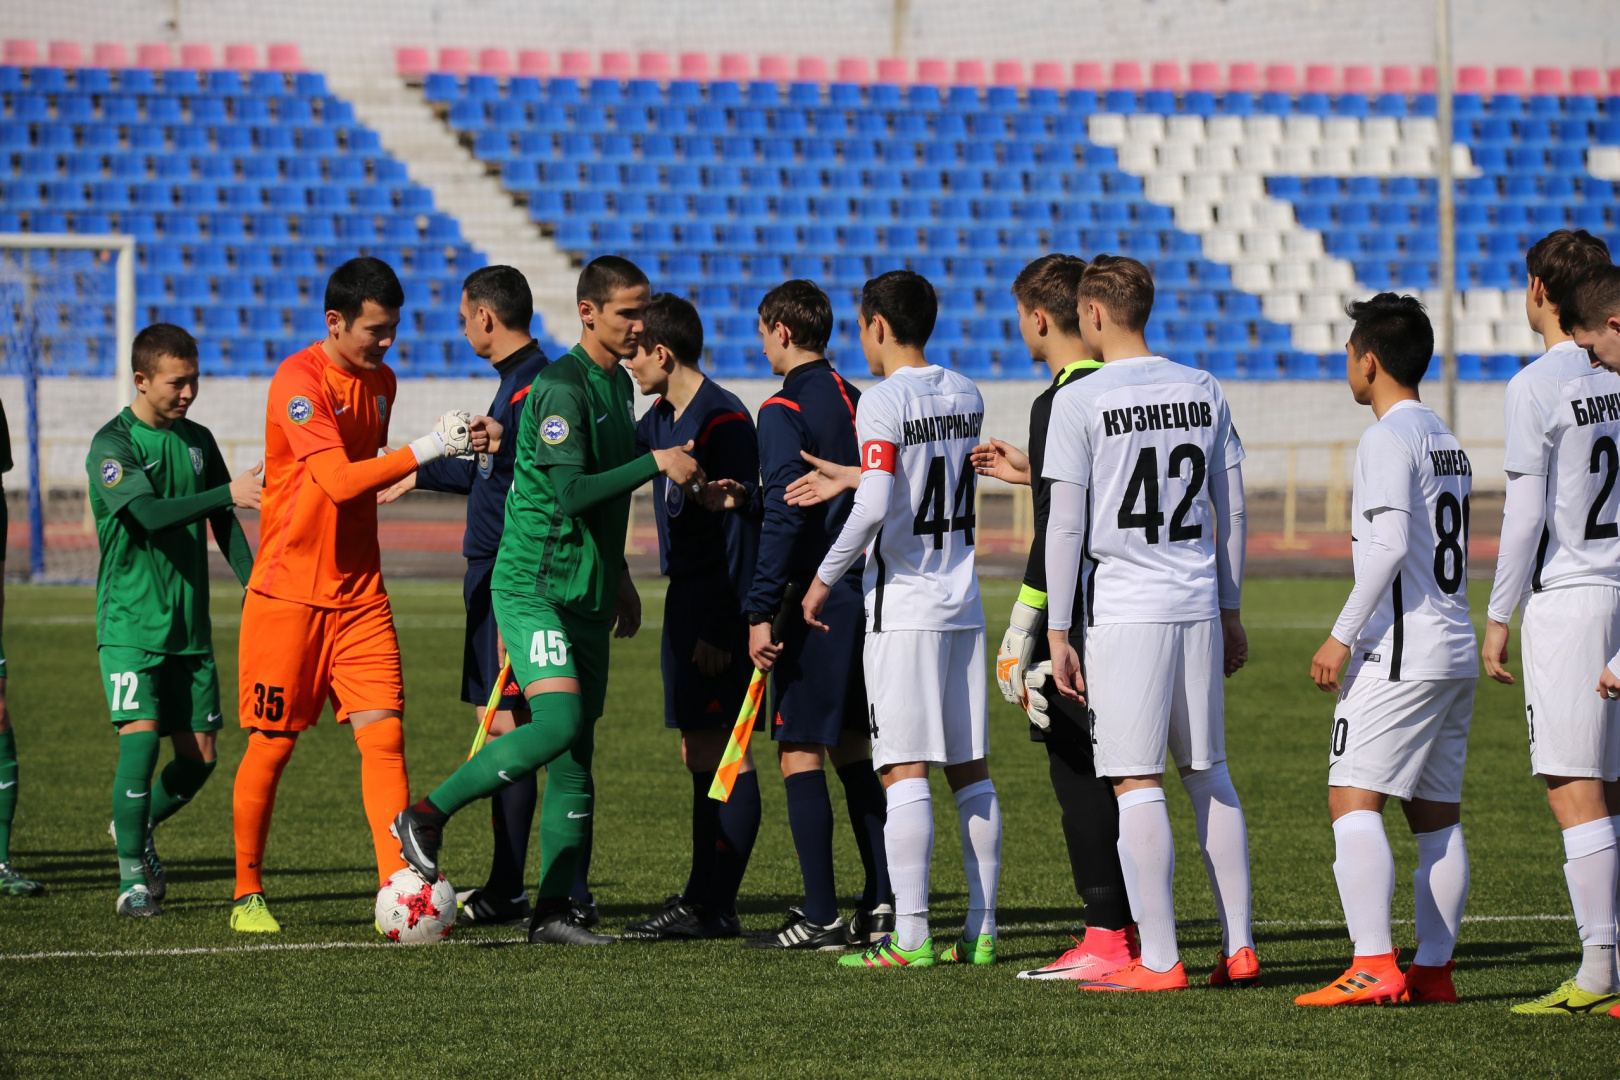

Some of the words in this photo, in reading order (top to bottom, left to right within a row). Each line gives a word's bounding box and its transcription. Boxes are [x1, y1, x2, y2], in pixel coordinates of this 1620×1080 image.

[1103, 401, 1212, 437] КУЗНЕЦОВ
[1571, 392, 1620, 427] БАРК
[867, 443, 882, 469] C
[913, 452, 976, 550] 44
[1117, 443, 1206, 545] 42
[529, 630, 568, 667] 45
[254, 682, 285, 722] 35
[1330, 717, 1349, 757] 0
